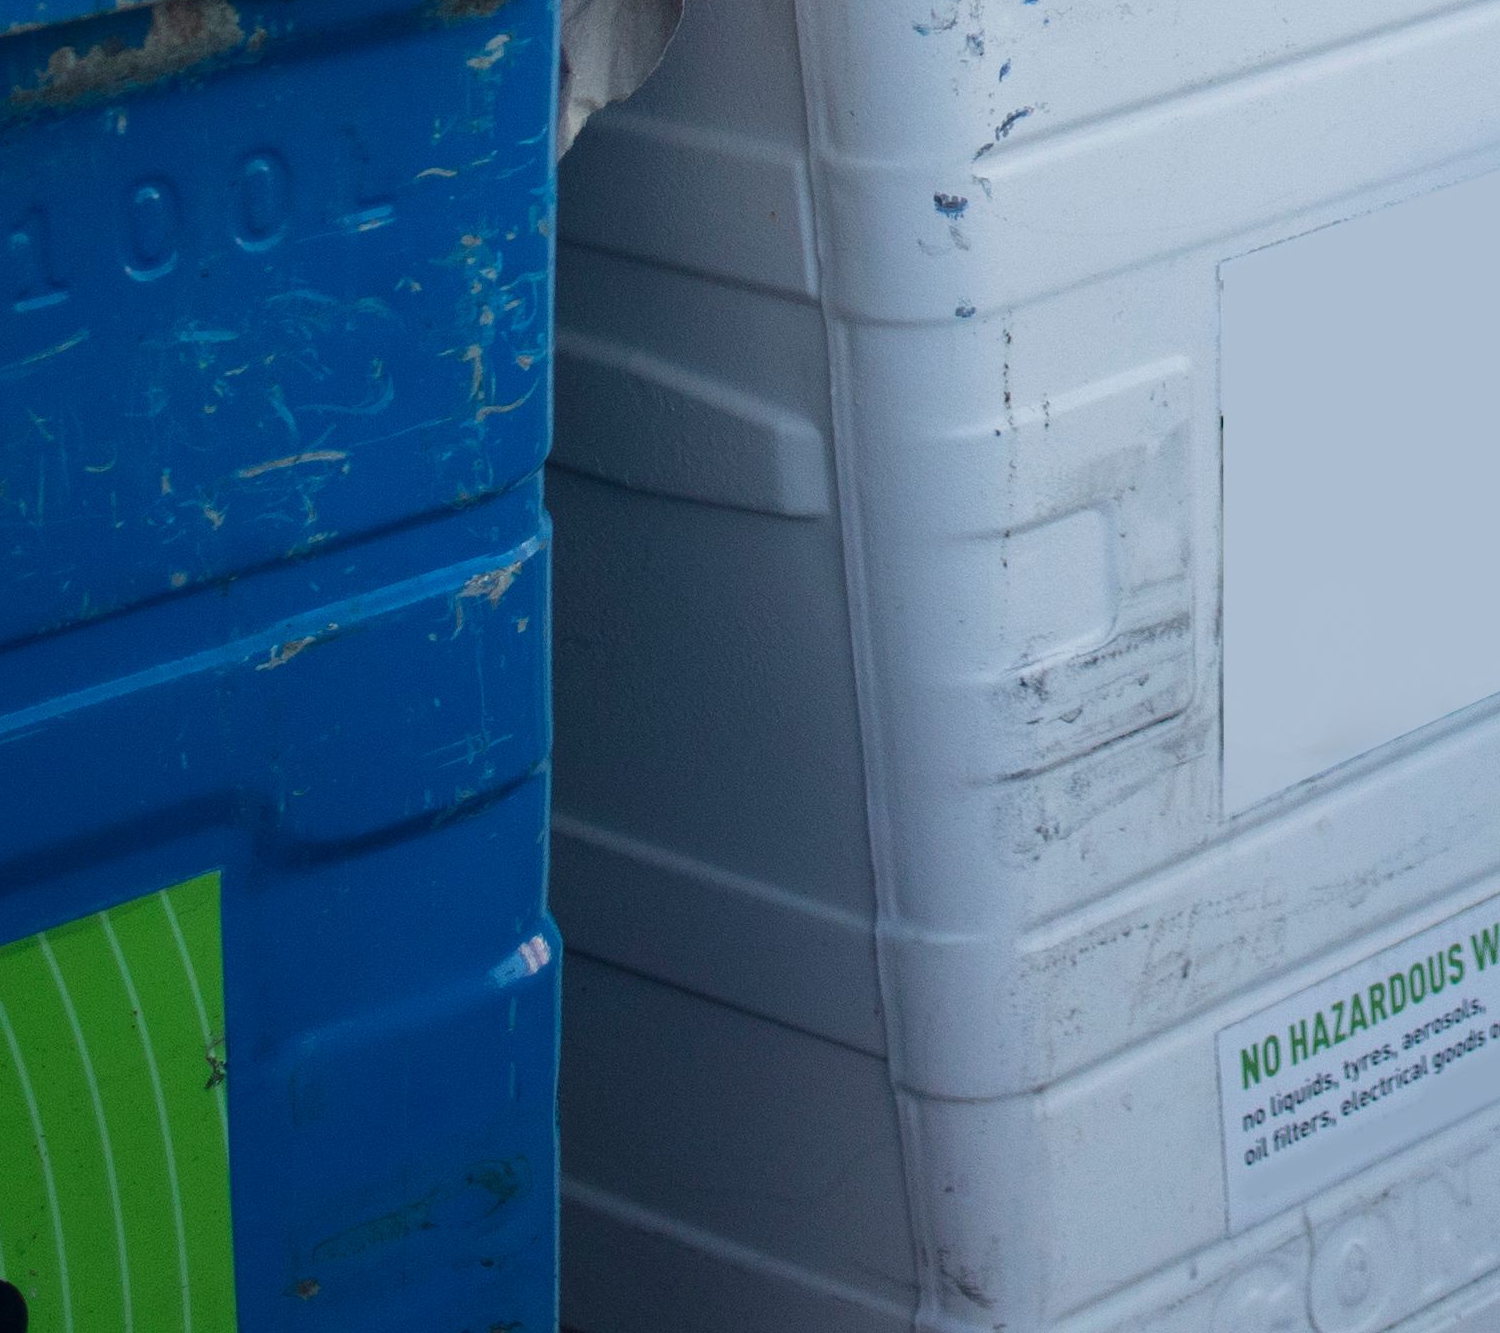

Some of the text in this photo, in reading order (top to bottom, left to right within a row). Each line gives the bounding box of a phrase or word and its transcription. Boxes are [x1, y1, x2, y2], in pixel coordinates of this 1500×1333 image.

[1239, 1034, 1282, 1090] NO
[1288, 942, 1465, 1066] HAZARDOUS
[1242, 996, 1488, 1133] no liquids, tyres, aerosols,
[1244, 1137, 1269, 1167] oil
[1272, 1109, 1338, 1153] filters,
[1339, 1054, 1429, 1118] electrical
[1431, 1027, 1488, 1075] goods
